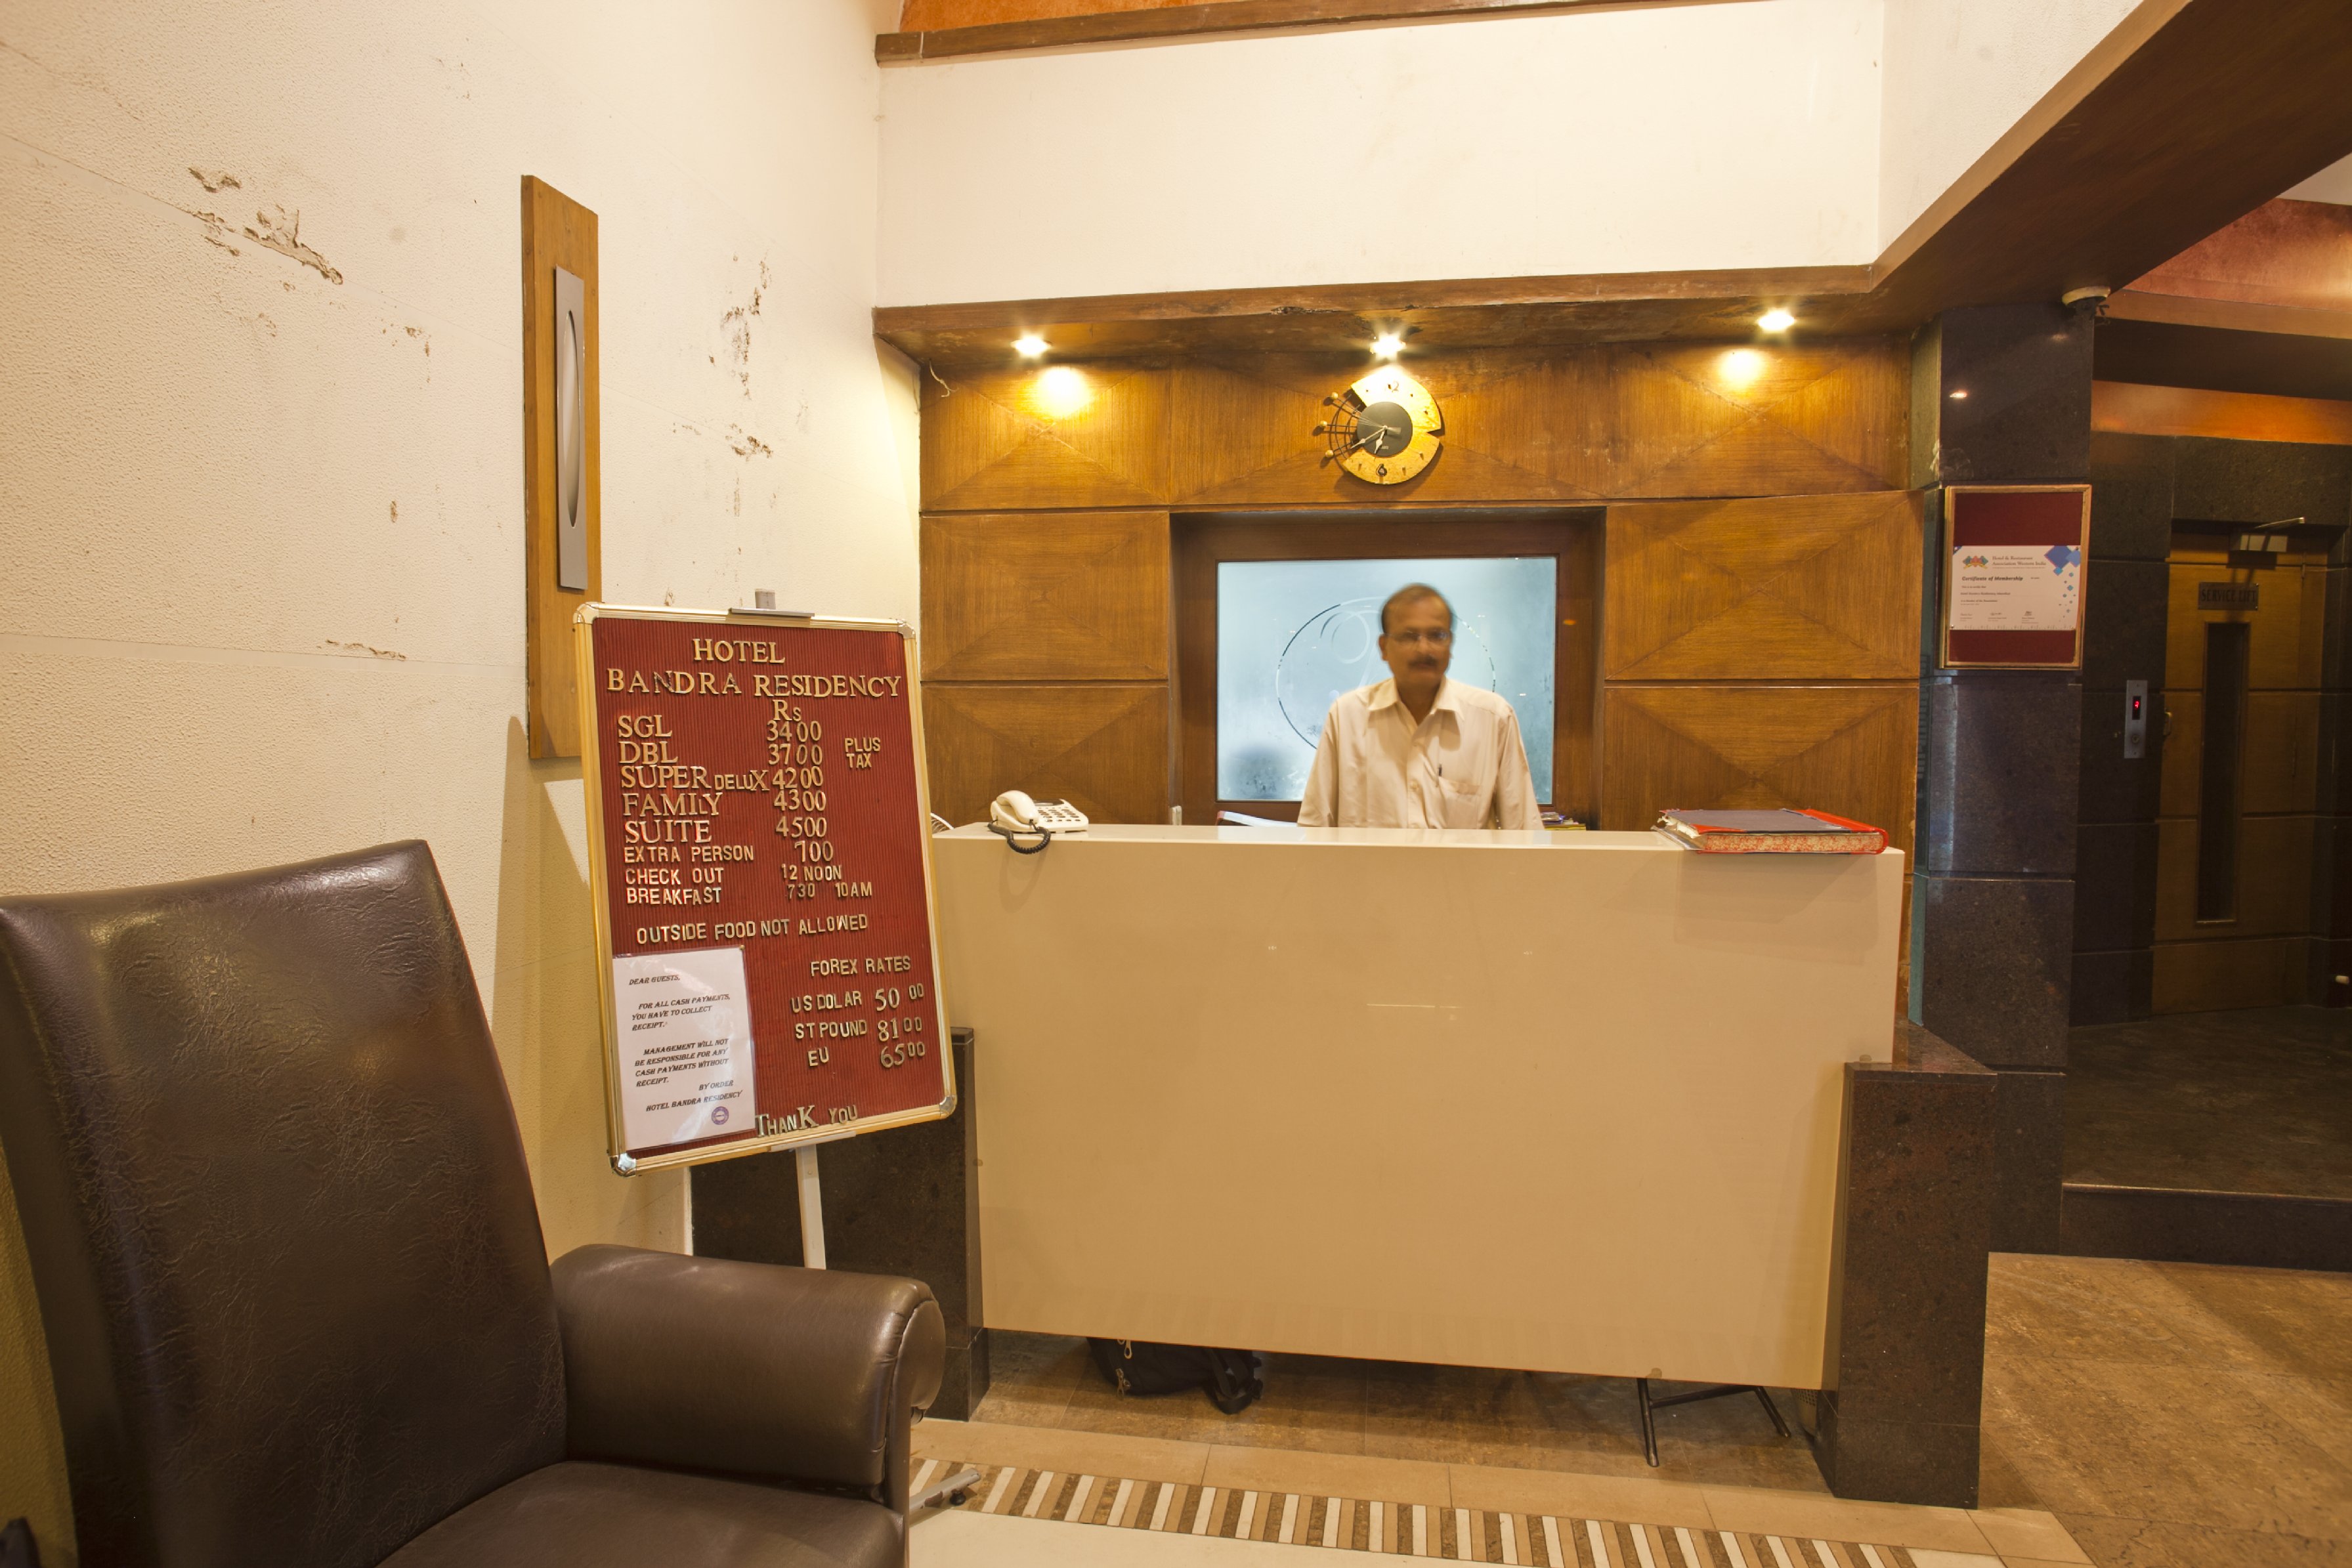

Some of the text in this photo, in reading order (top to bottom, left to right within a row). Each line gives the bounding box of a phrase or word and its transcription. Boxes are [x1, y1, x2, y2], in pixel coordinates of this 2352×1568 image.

[2201, 589, 2257, 603] SERVICE LIFT
[693, 639, 785, 664] HOTEL
[607, 668, 901, 698] BANDRA RESIDENCY
[618, 715, 823, 742] SGL 3400
[619, 741, 823, 765] DBL 3700
[844, 737, 881, 753] PLUS
[847, 753, 872, 769] TAX
[621, 765, 823, 791] SUPER DELUX 4200
[623, 788, 826, 816] FAMILY 4300
[625, 816, 827, 843] SUITE 4500
[624, 840, 834, 862] EXTRA PERSON 700
[625, 864, 842, 885] CHECK OUT 12 NOON
[627, 887, 721, 905] BREAKFAST
[637, 914, 868, 944] OUTSIDE FOOD NOT ALLOWED
[811, 956, 910, 976] FOREX RATES
[630, 977, 649, 985] DEAR
[691, 994, 731, 1004] PAYMENTS,
[791, 996, 812, 1013] US
[817, 991, 862, 1009] DOLAR
[648, 1010, 668, 1019] HAVE
[681, 1006, 712, 1015] COLLECT
[632, 1021, 665, 1031] RECEIPT.
[796, 1023, 815, 1038] ST
[819, 1020, 867, 1038] POUND
[643, 1042, 696, 1055] MANAGEMENT
[697, 1040, 714, 1048] WILL
[647, 1053, 695, 1065] RESPONSIBLE
[712, 1048, 729, 1056] ANY
[808, 1047, 830, 1067] EU
[635, 1058, 730, 1077] CASH PAYMENTS WITHOUT
[636, 1077, 669, 1087] RECEIPT.
[698, 1080, 734, 1091] BY ORDER
[646, 1090, 743, 1112] HOTEL BANDRA RESIDENCY
[828, 1105, 858, 1125] YOU
